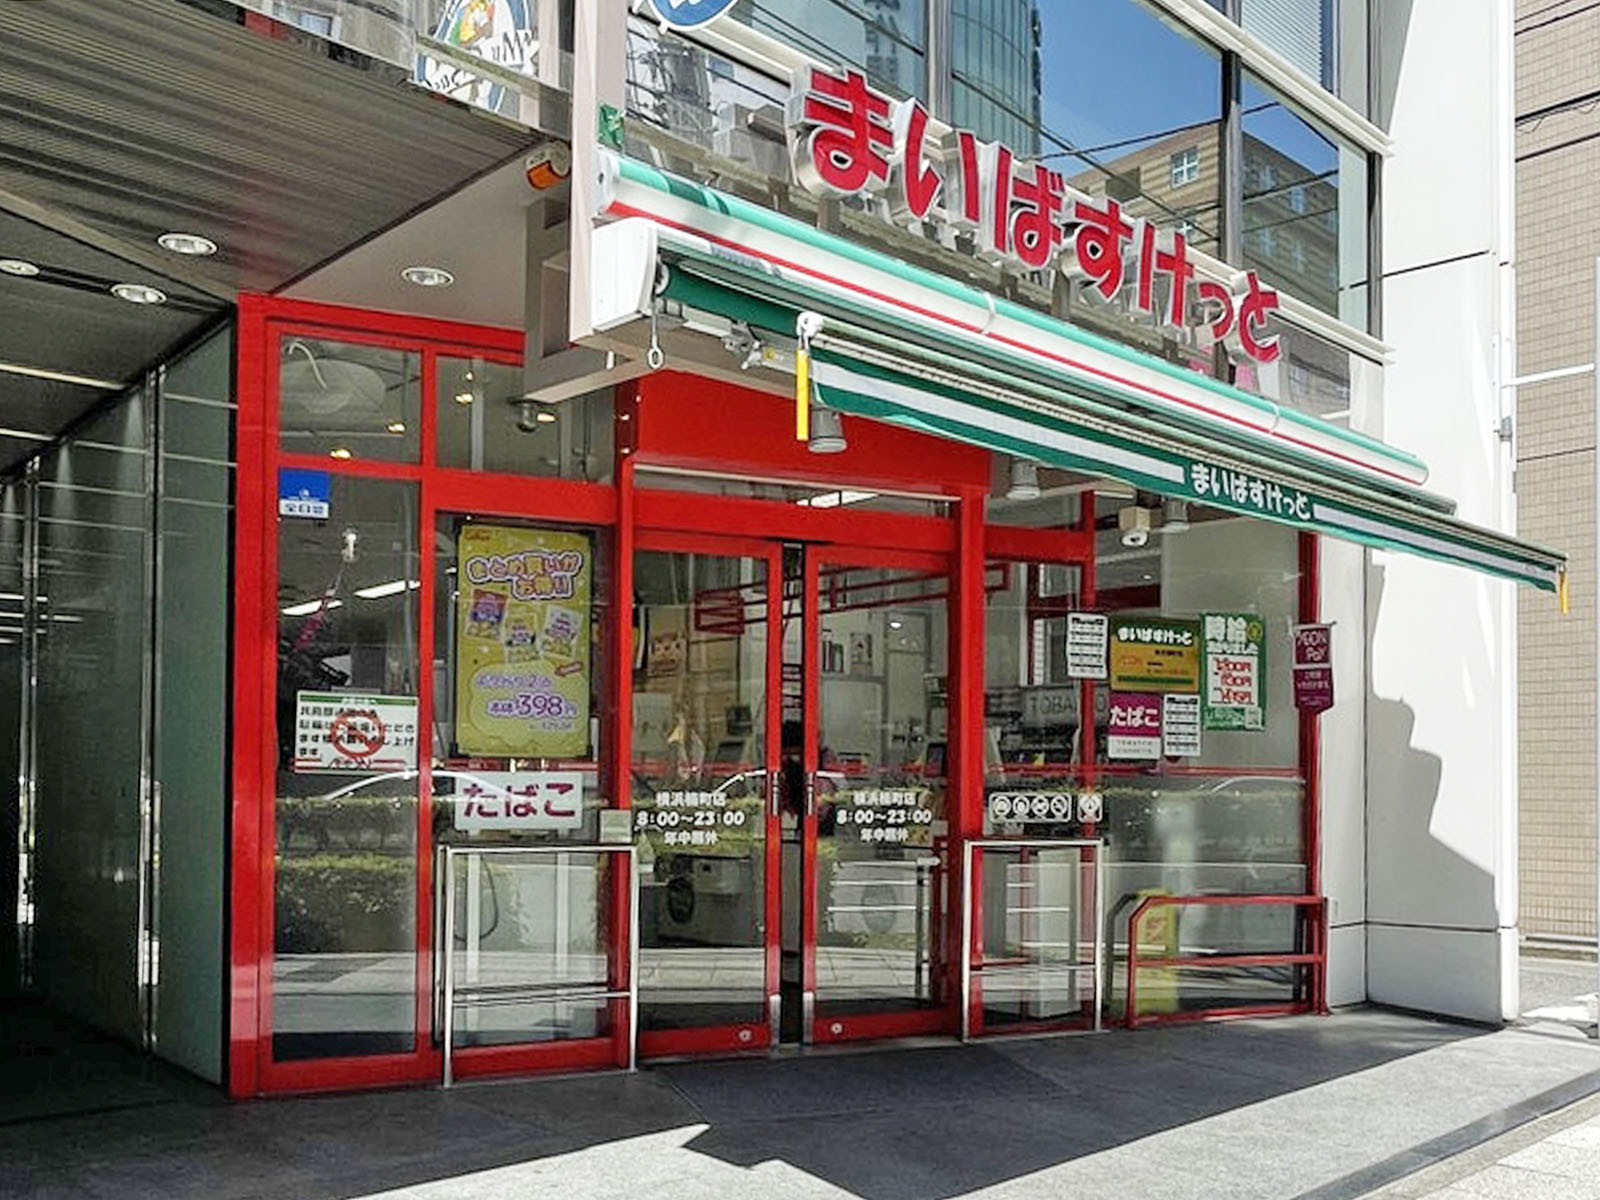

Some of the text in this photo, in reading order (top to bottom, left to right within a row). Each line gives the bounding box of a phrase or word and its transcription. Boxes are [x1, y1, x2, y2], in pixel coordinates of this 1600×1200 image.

[803, 67, 1282, 364] まいばすけっと
[1190, 462, 1311, 520] まいばすけっと
[1109, 705, 1159, 727] たばこ
[463, 783, 575, 817] たばこ
